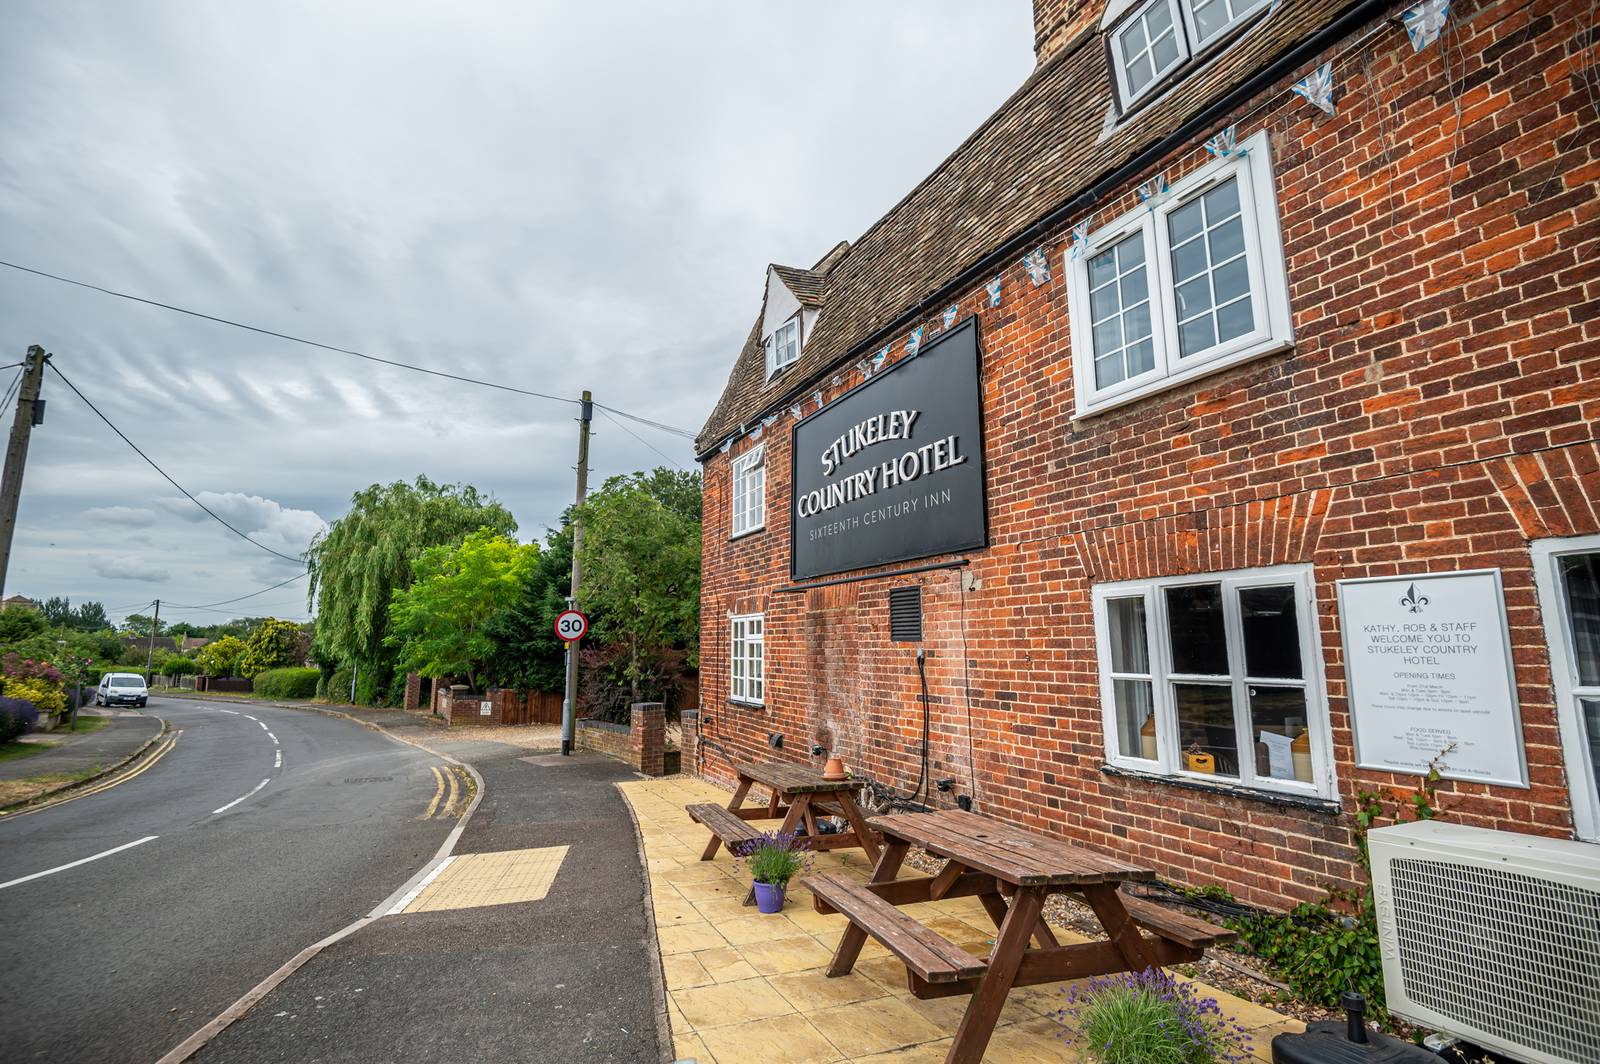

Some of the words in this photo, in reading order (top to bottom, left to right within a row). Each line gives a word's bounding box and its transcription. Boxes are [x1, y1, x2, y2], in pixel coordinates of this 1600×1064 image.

[821, 410, 917, 476] STUKELEY
[798, 466, 877, 518] COUNTRY
[882, 435, 966, 489] HOTEL
[809, 516, 859, 541] SIXTEENTH
[863, 498, 918, 525] CENTURY
[924, 488, 951, 508] INN
[560, 619, 582, 633] 30
[1403, 623, 1427, 632] ROB
[1430, 623, 1438, 632] &
[1441, 622, 1478, 632] STAFF
[1371, 635, 1424, 643] WELCOME
[1427, 634, 1451, 643] YOU
[1454, 634, 1471, 643] TO
[1367, 645, 1419, 654] STUKELEY
[1422, 645, 1478, 654] COUNTRY
[1403, 656, 1440, 665] HOTEL
[1431, 672, 1456, 680] TIMES
